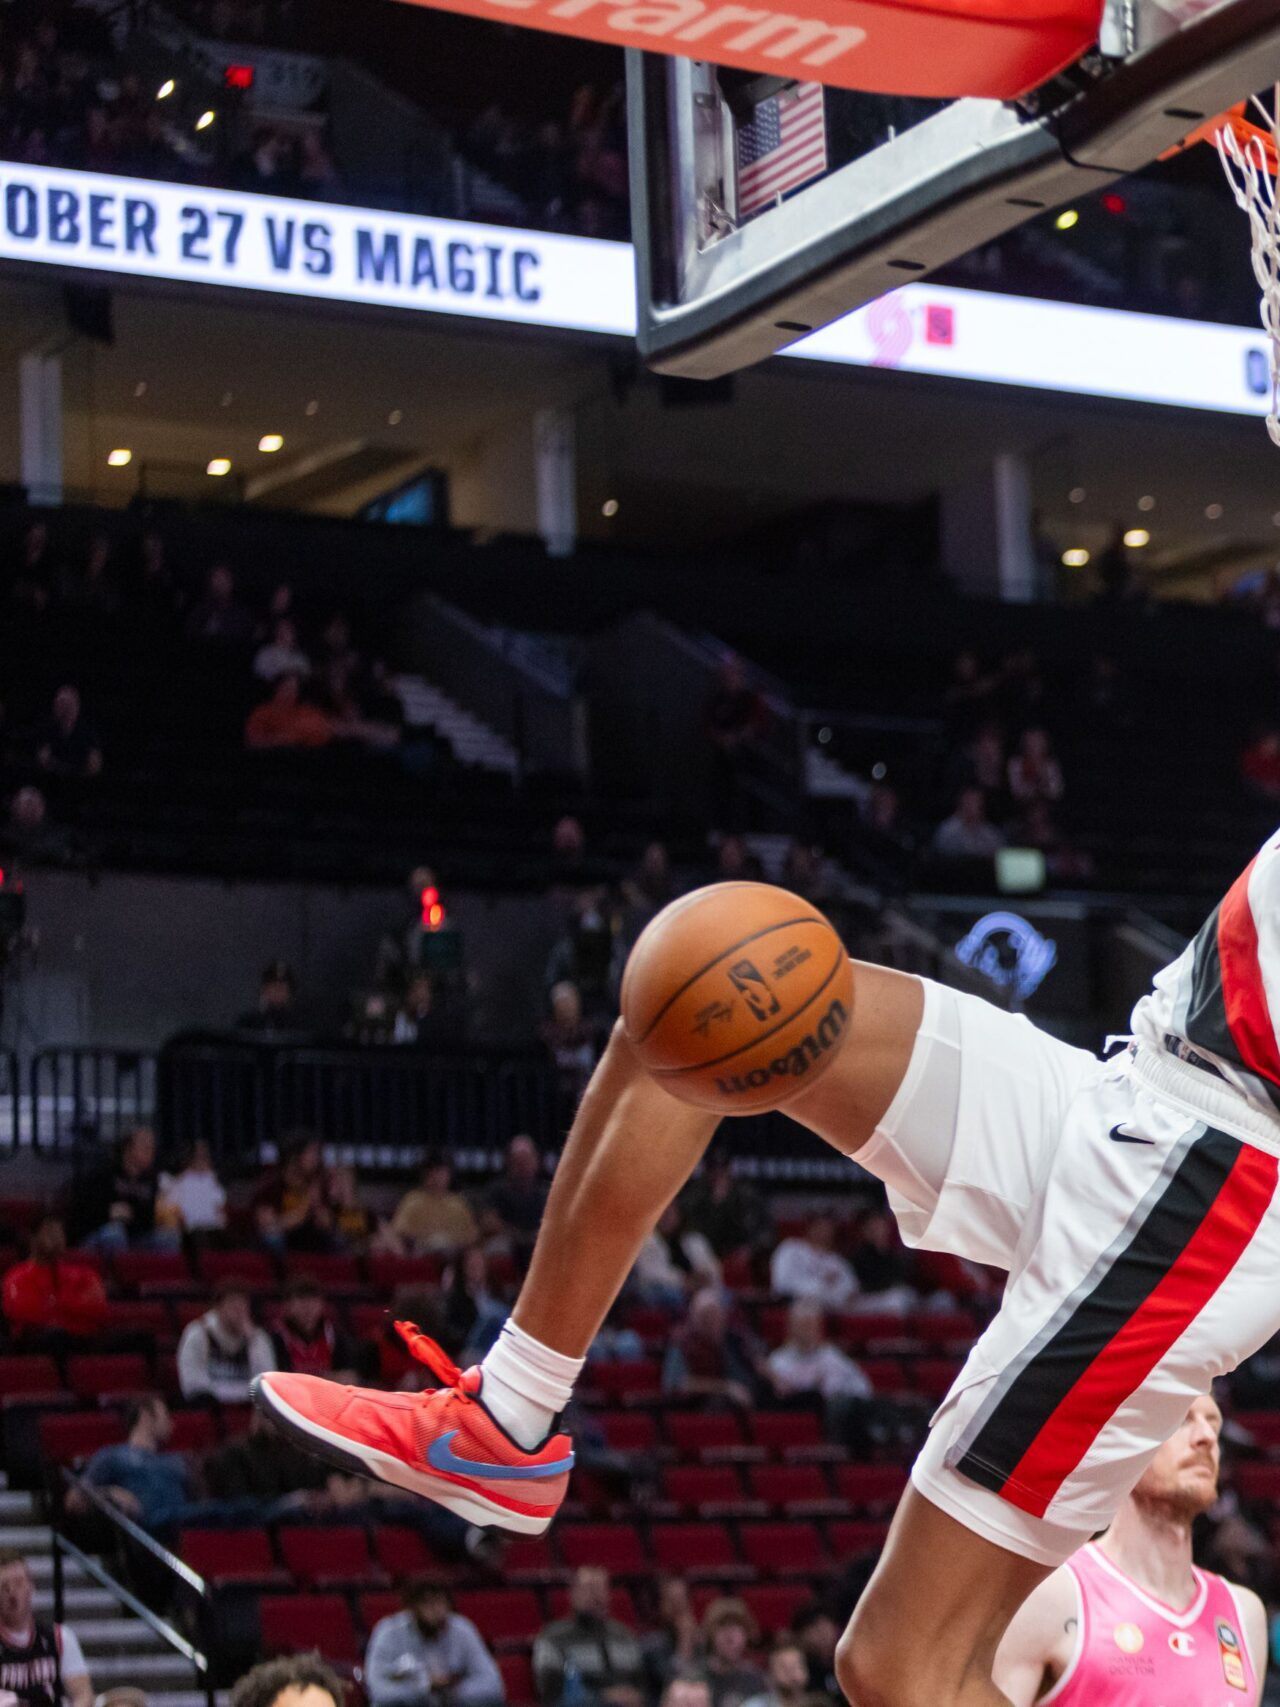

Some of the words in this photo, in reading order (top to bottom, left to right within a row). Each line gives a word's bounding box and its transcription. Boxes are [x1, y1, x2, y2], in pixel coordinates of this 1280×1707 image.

[5, 182, 157, 256] OBER
[181, 205, 244, 264] 27
[265, 217, 333, 276] VS
[356, 229, 541, 301] MAGIC
